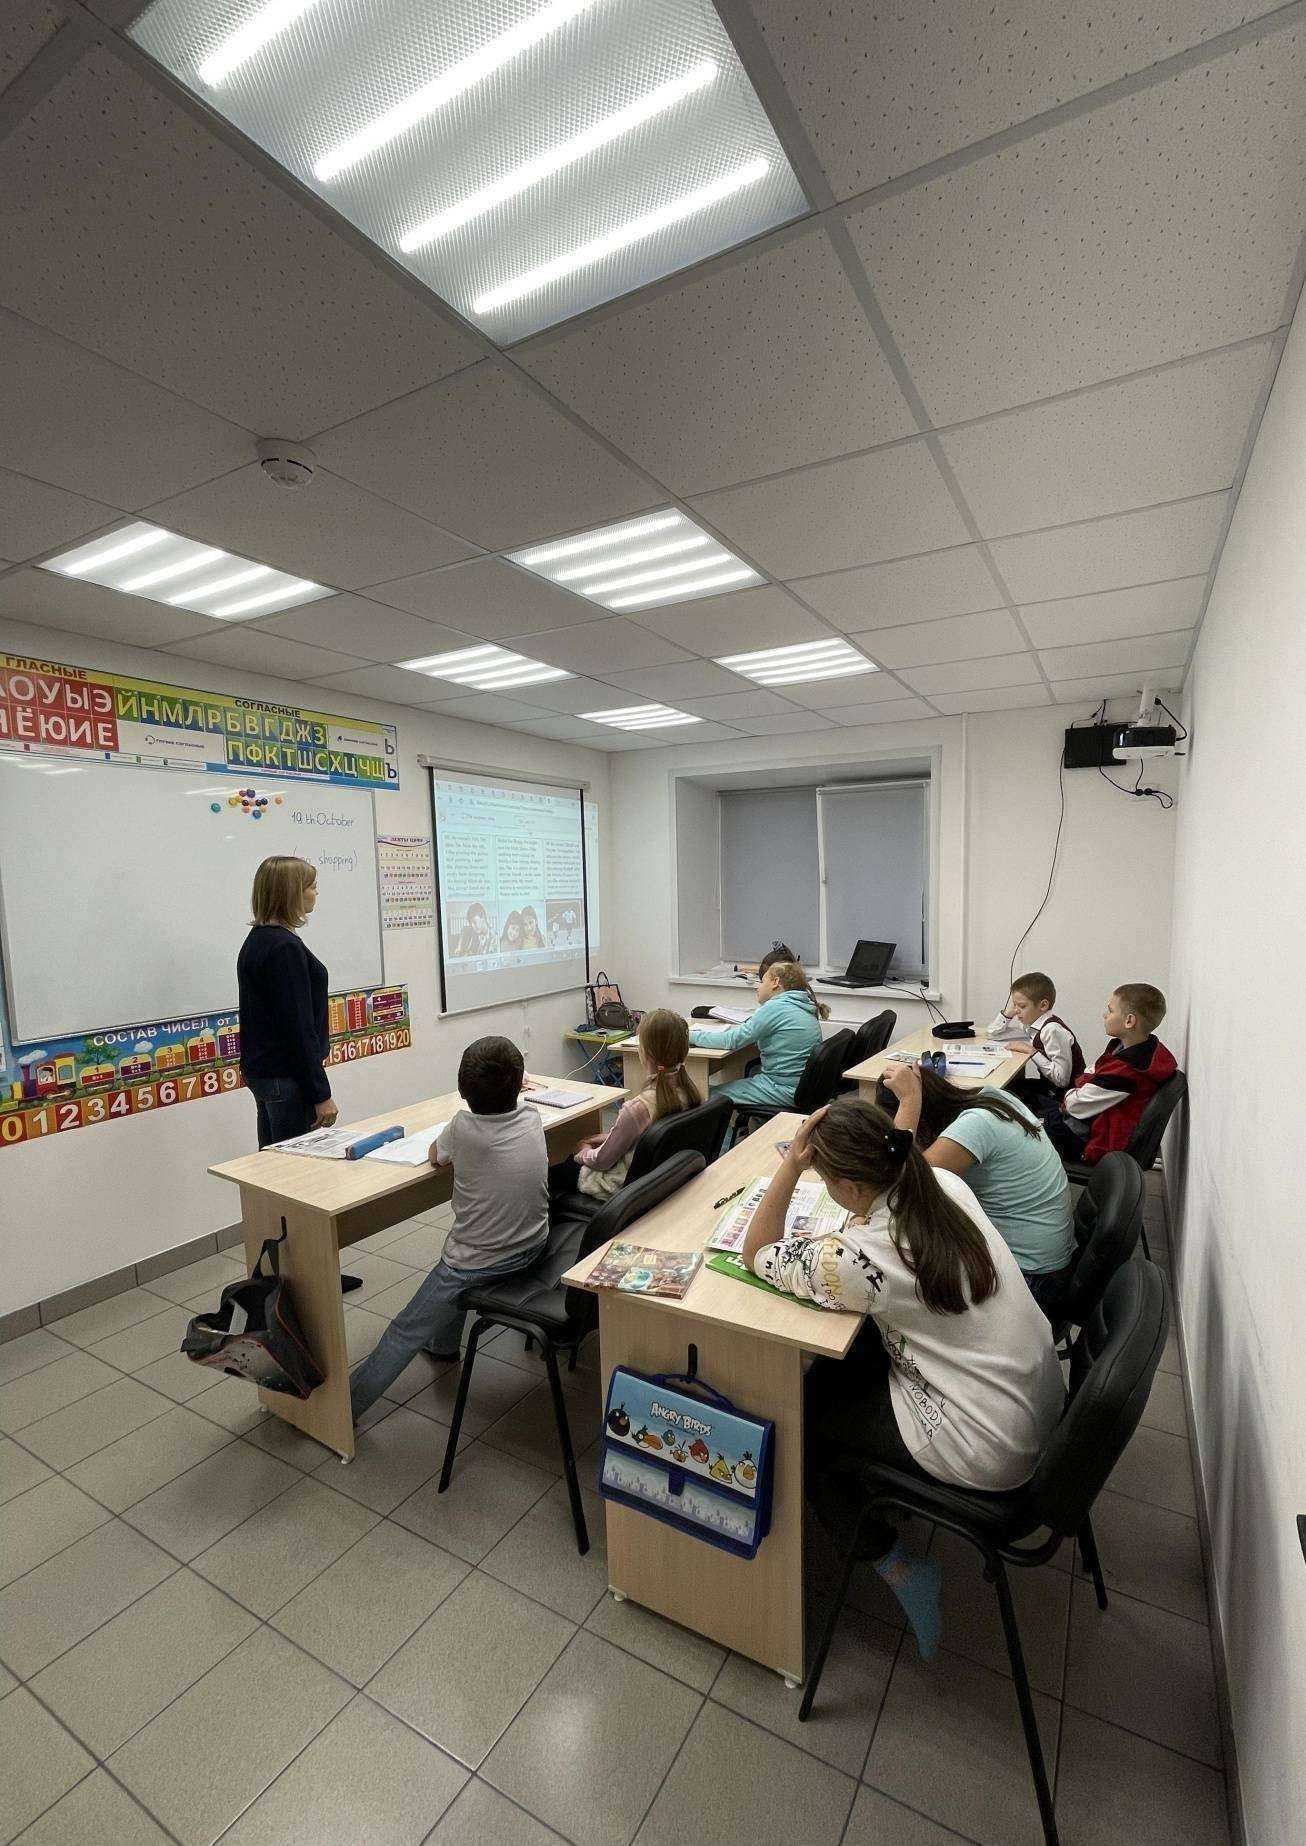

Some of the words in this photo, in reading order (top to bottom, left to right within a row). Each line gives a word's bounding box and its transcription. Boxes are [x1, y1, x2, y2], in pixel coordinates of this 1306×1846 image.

[5, 656, 87, 680] ГЛАСНЫЕ
[235, 699, 301, 718] СОГЛАСНЫЕ
[93, 1026, 158, 1047] СОСТАВ
[162, 1018, 209, 1035] ЧИСЕЛ
[217, 1017, 231, 1027] от
[2, 1116, 23, 1141] 0
[33, 1110, 48, 1134] 1
[60, 1104, 80, 1130] 2
[88, 1098, 105, 1121] 3
[110, 1092, 130, 1115] 4
[137, 1086, 154, 1109] 5
[160, 1081, 176, 1104] 6
[182, 1076, 197, 1099] 7
[204, 1072, 219, 1093] 8
[222, 1068, 238, 1089] 9
[342, 1041, 356, 1061] 16
[357, 1038, 369, 1057] 17
[371, 1035, 384, 1053] 18
[385, 1032, 397, 1050] 19
[397, 1029, 410, 1047] 20
[650, 1401, 682, 1425] ANGRY
[681, 1414, 713, 1436] BIRDS
